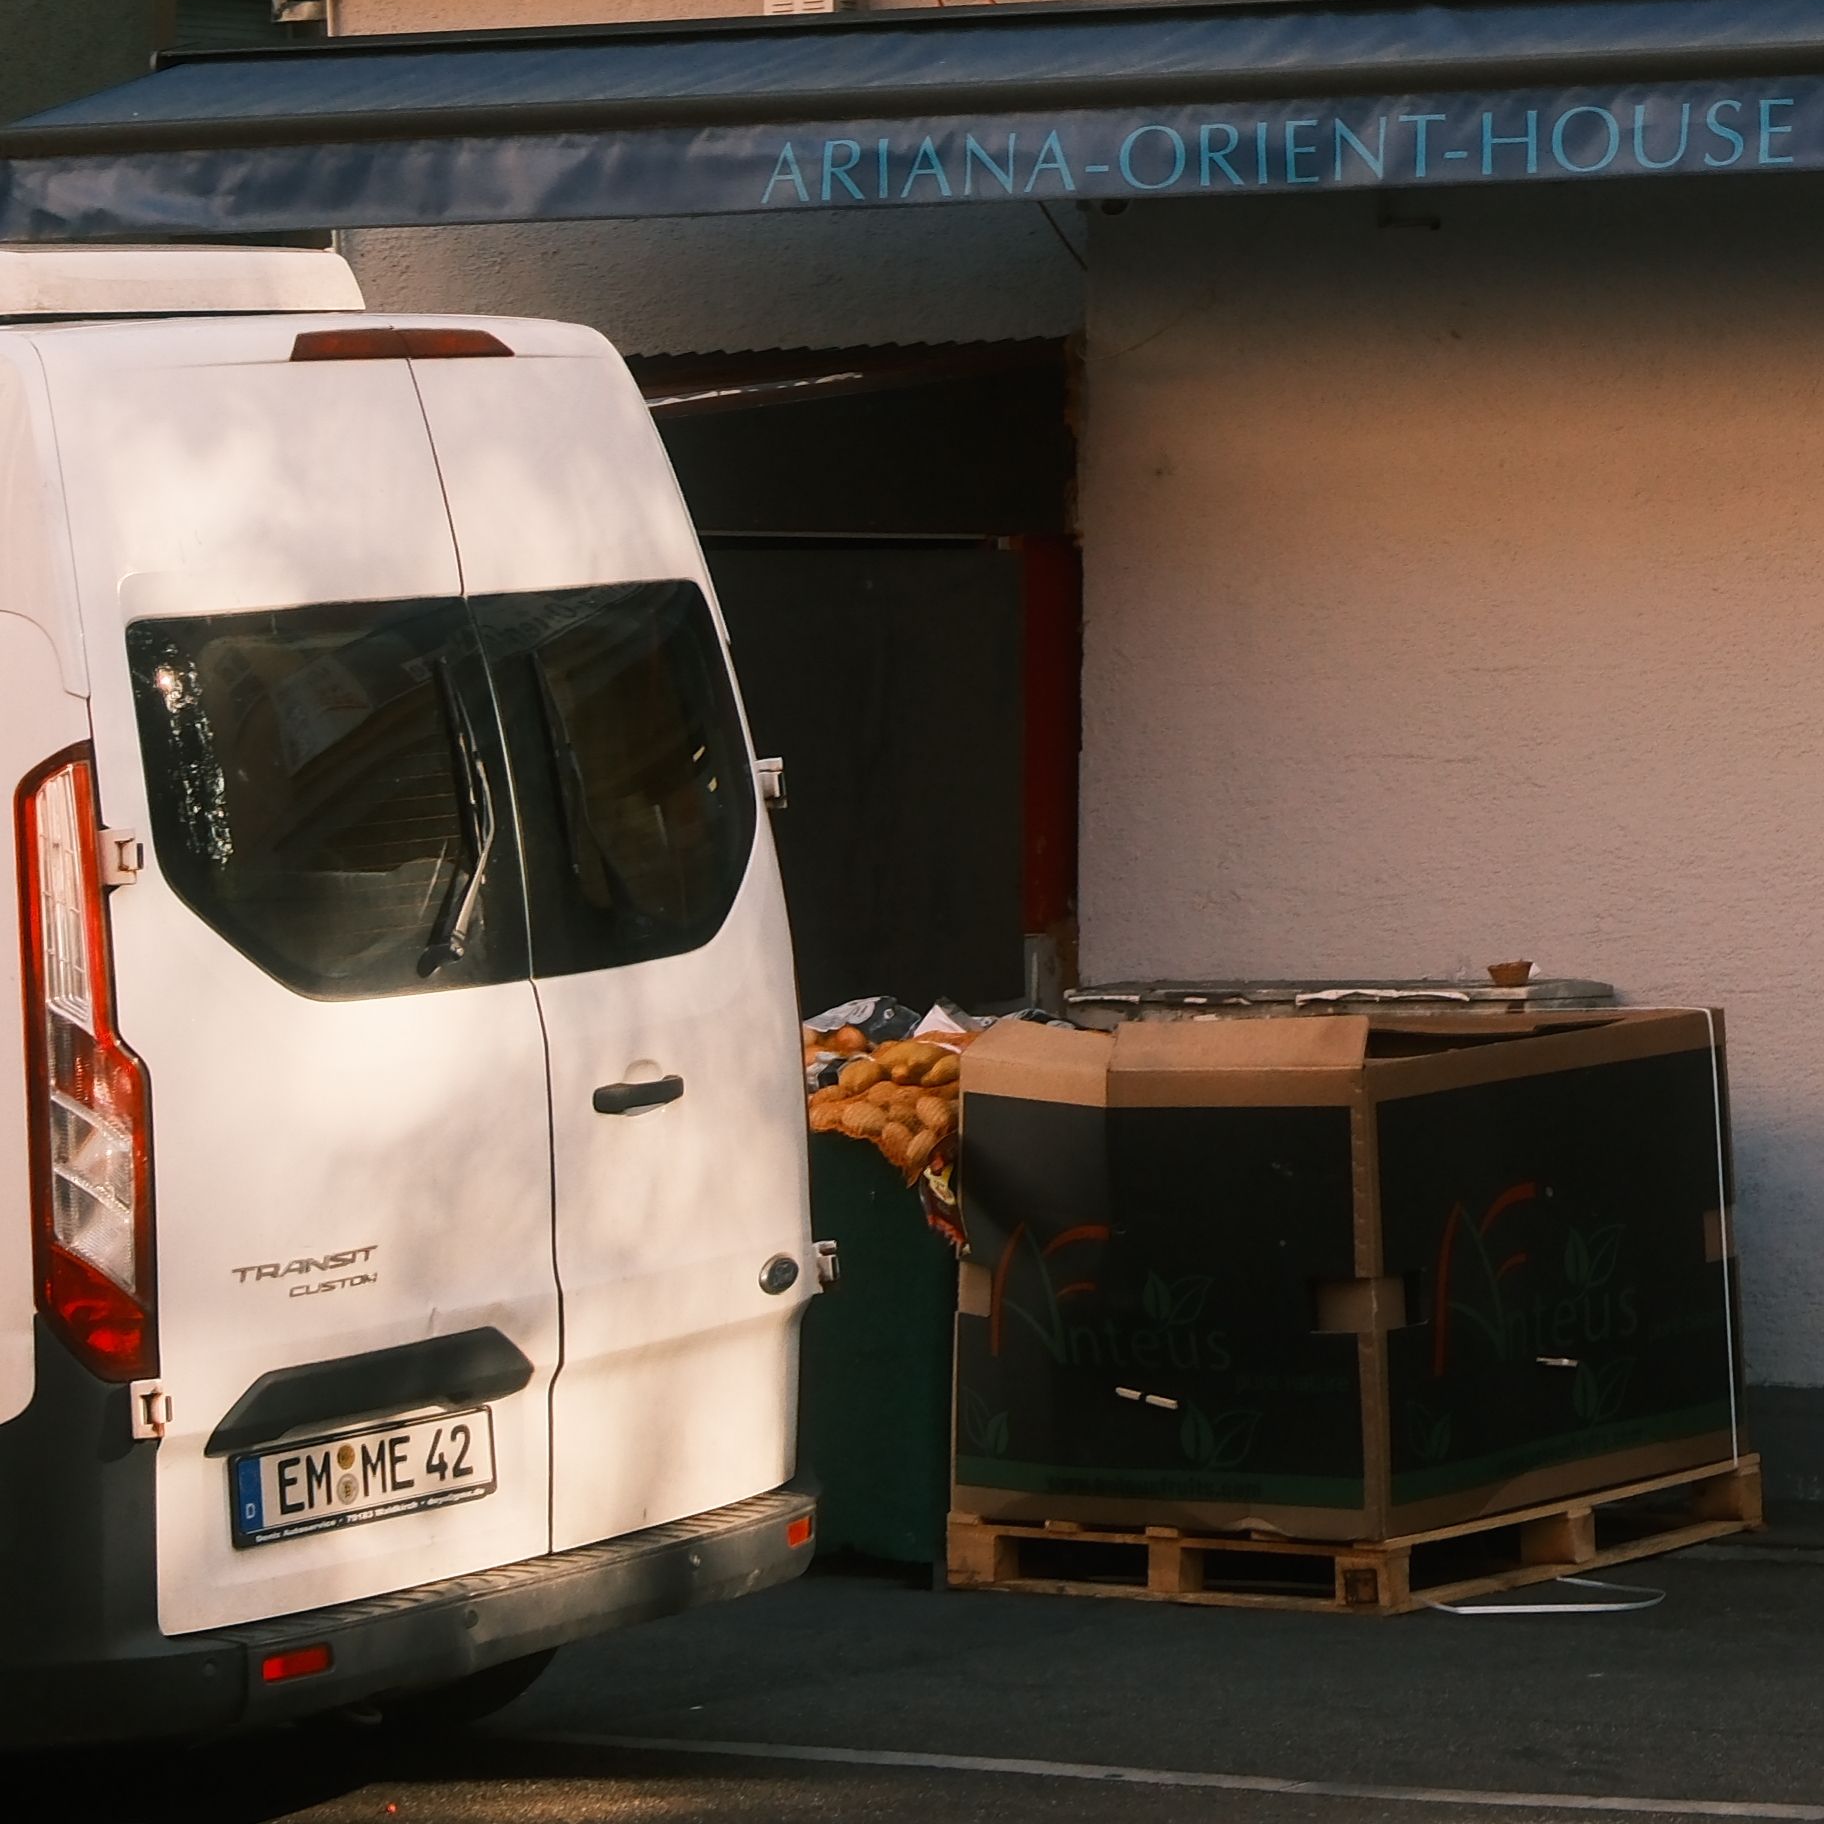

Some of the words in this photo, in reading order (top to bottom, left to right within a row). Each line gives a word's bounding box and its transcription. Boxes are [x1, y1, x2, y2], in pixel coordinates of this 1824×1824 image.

[761, 97, 1796, 204] ARIANA-ORIENT-HOUSE
[231, 1244, 379, 1284] TRANSIT
[288, 1272, 378, 1298] CUSTOM
[278, 1451, 334, 1516] EM
[361, 1434, 416, 1497] ME
[426, 1423, 474, 1482] 42
[245, 1501, 256, 1519] D
